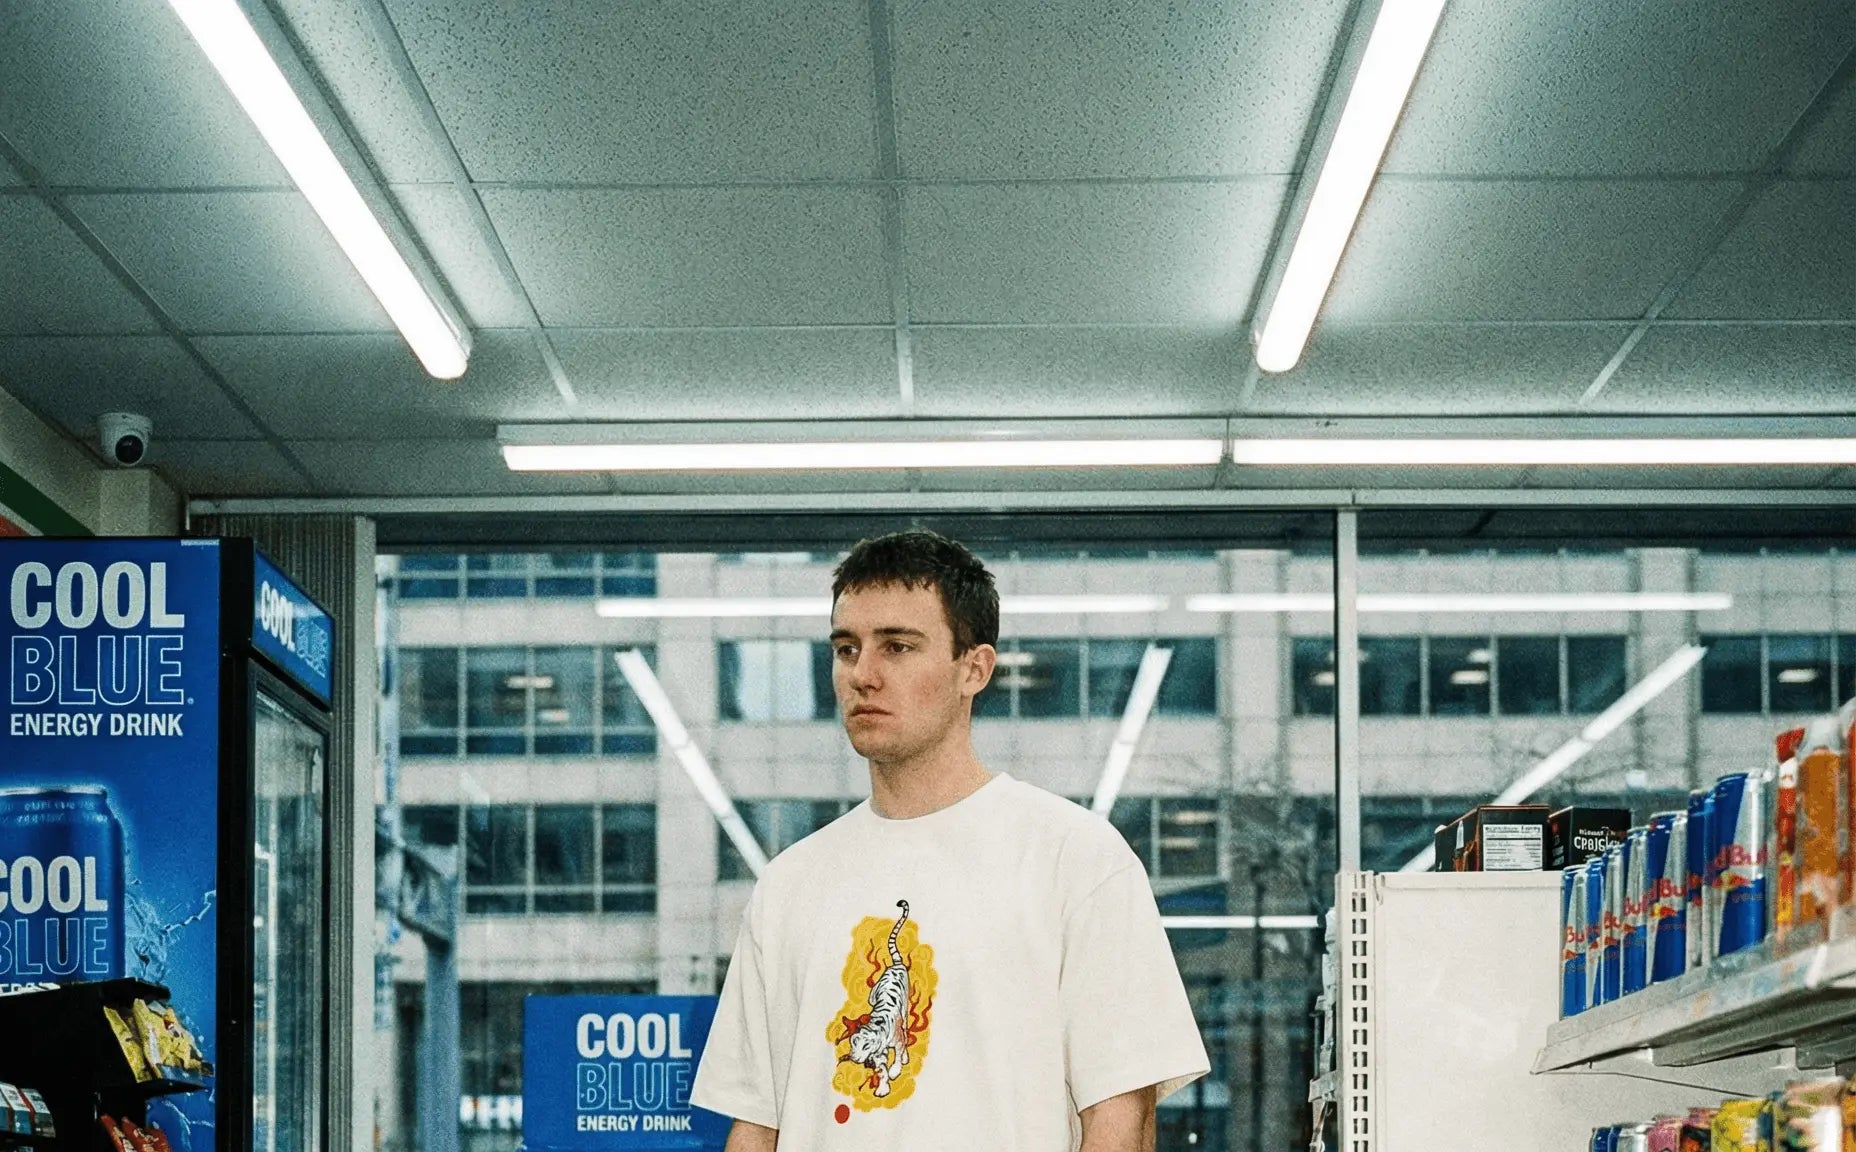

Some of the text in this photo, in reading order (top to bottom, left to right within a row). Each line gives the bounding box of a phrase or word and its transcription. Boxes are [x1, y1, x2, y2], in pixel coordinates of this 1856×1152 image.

[10, 561, 185, 629] COOL
[261, 580, 295, 653] COOL
[11, 635, 185, 706] BLUE
[10, 713, 184, 737] ENERGY DRINK
[576, 1013, 693, 1059] COOL
[576, 1062, 692, 1111] BLUE
[577, 1114, 692, 1132] ENERGY DRINK
